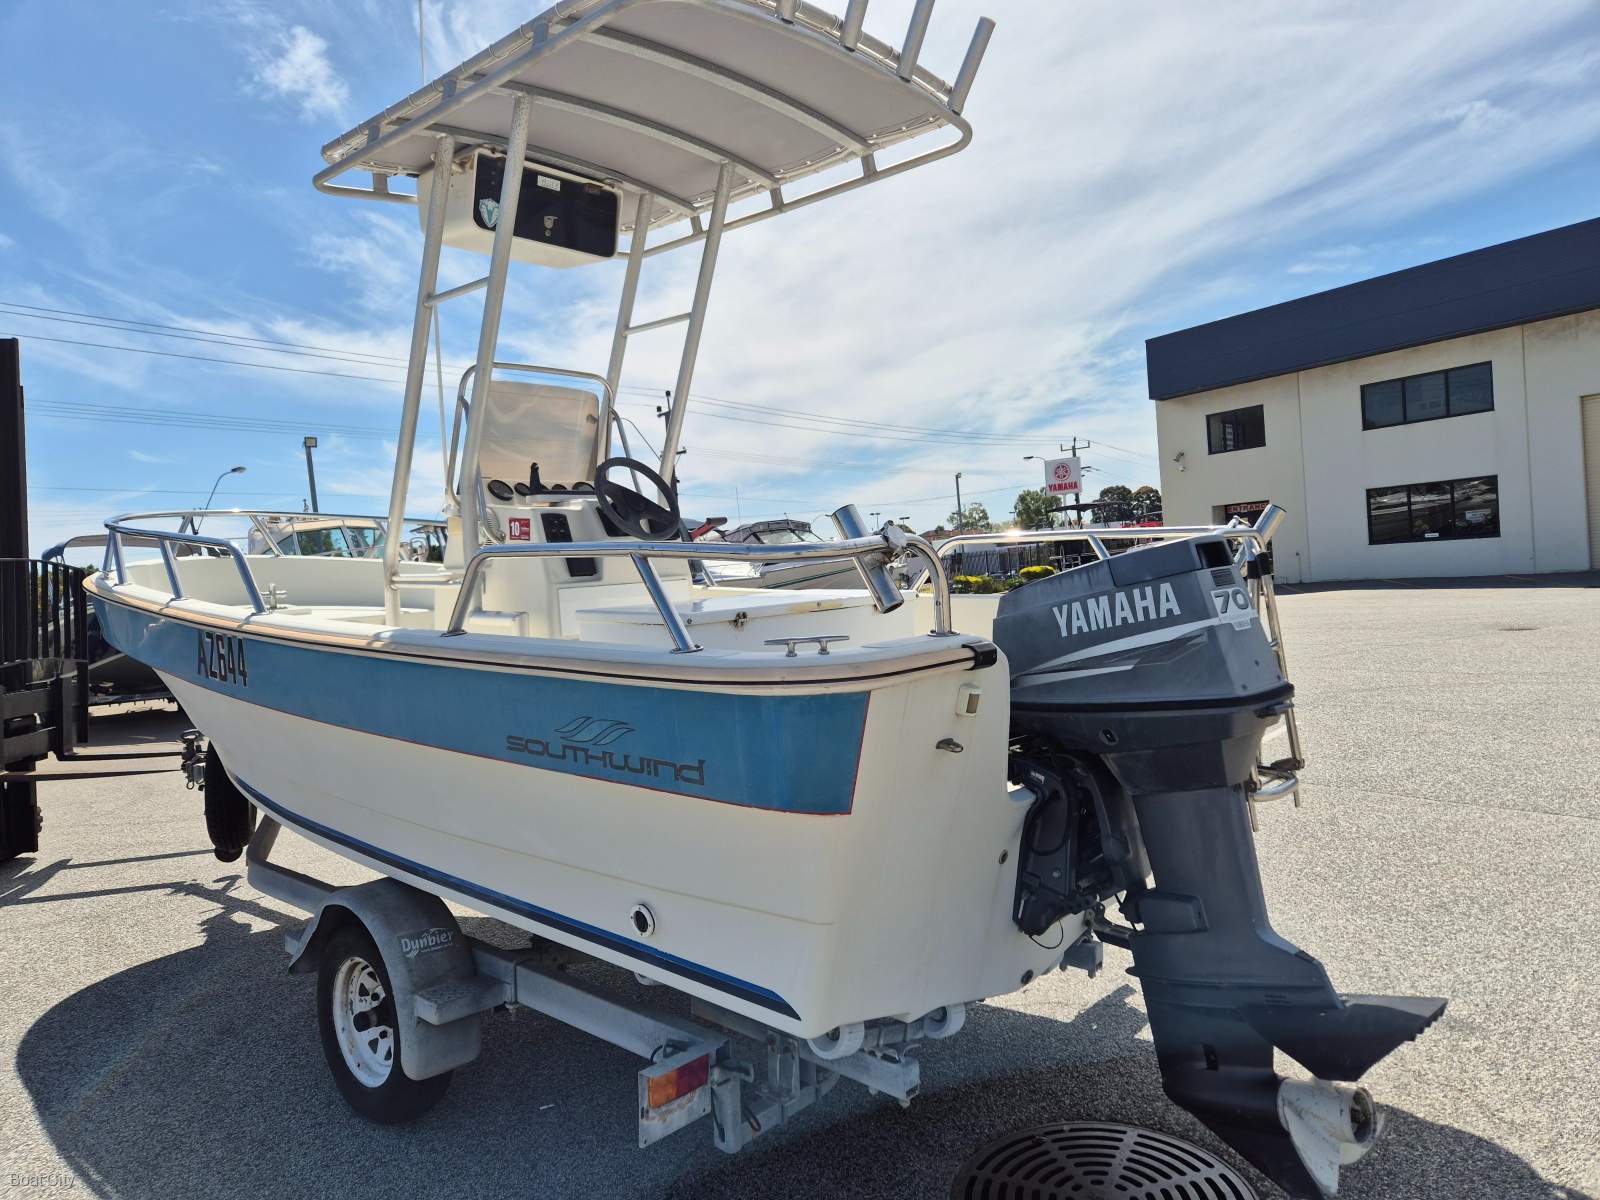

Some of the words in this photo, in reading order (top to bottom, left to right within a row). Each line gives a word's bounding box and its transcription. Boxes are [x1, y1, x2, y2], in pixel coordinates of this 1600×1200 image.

[1048, 481, 1079, 492] YAMAHA
[510, 521, 520, 536] 10
[1052, 582, 1181, 637] YAMAHA
[1213, 588, 1249, 614] 70
[197, 629, 247, 687] AZ644
